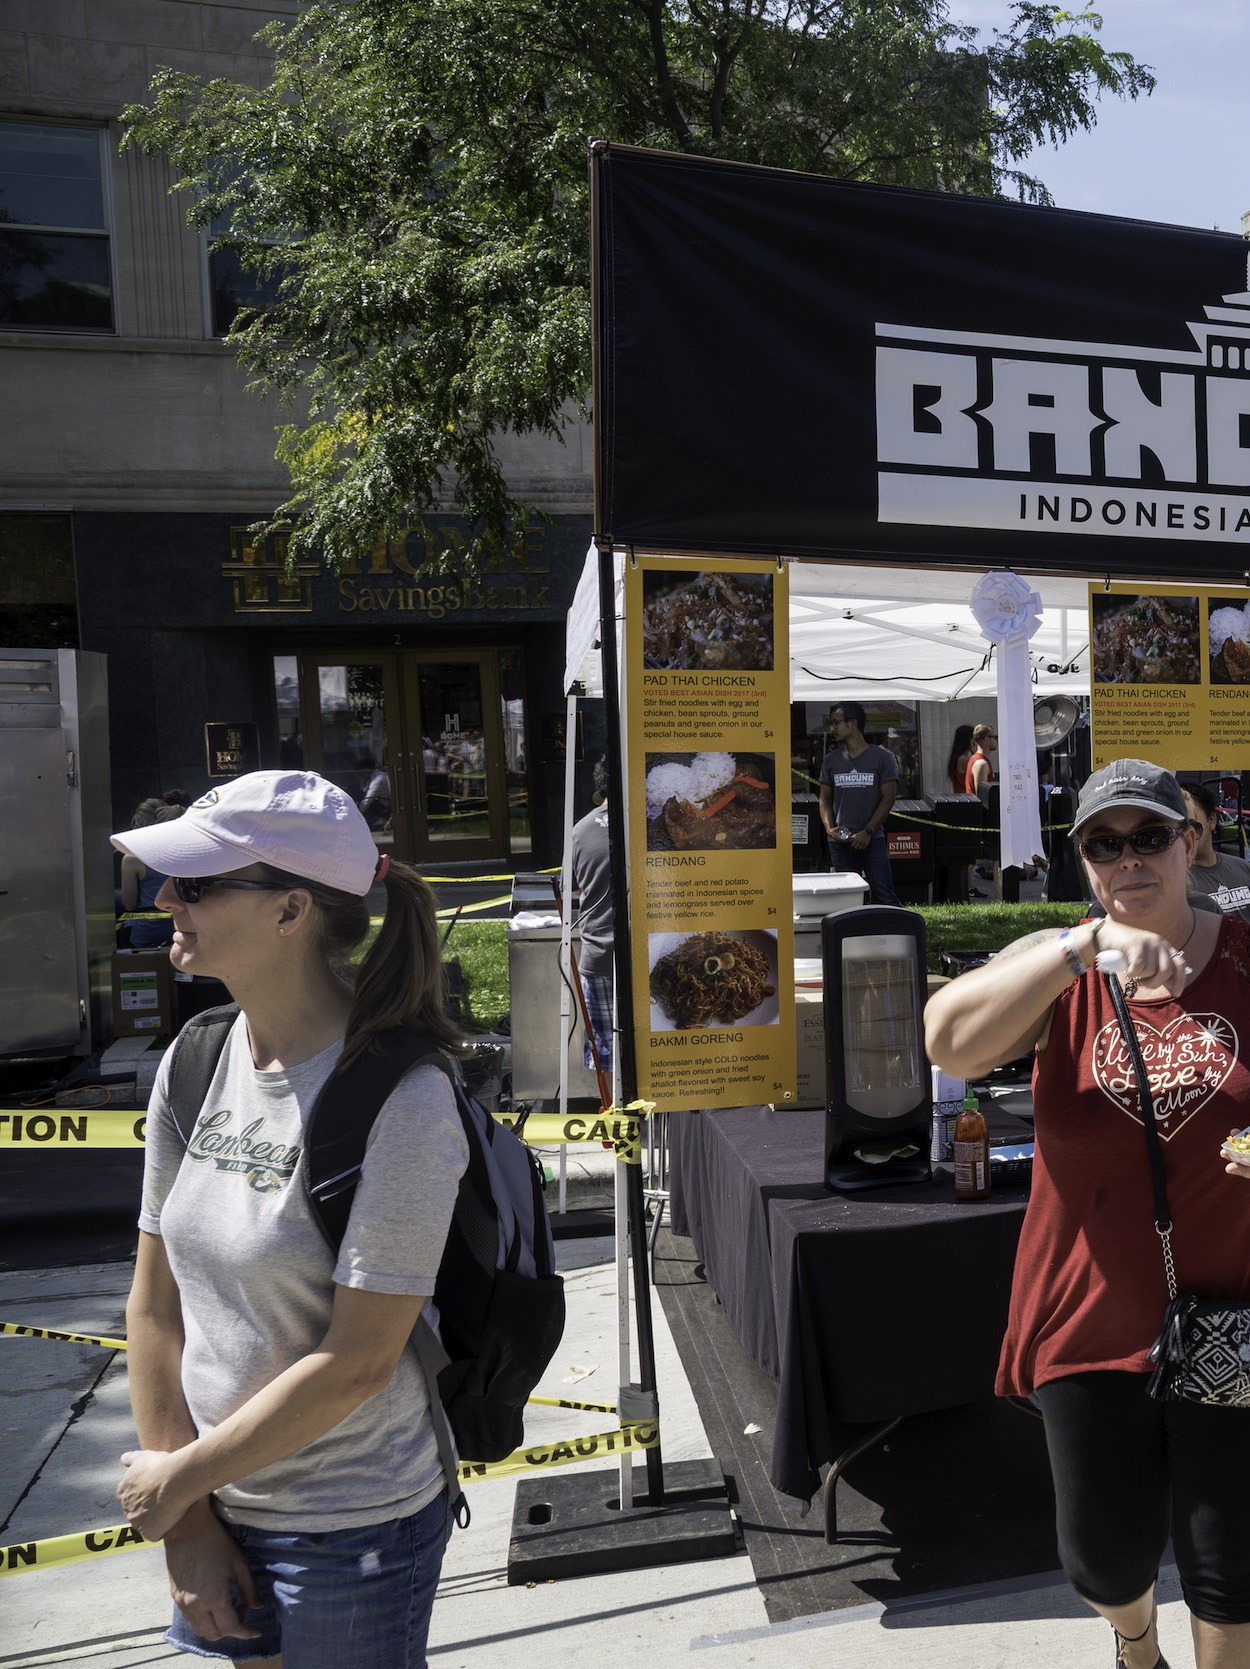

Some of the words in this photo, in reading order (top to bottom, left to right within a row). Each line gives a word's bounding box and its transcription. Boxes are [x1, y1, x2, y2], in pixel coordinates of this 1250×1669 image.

[394, 634, 402, 644] 2
[644, 676, 667, 685] PAD
[671, 676, 698, 686] THAI
[702, 676, 755, 686] CHICKEN
[1094, 689, 1114, 698] PAD
[1117, 689, 1139, 698] THAI
[1142, 690, 1186, 698] CHICKEN
[732, 710, 759, 718] ground
[440, 732, 466, 740] HOME
[644, 731, 672, 739] special
[764, 730, 773, 738] $4
[216, 751, 247, 762] HOM
[1095, 757, 1103, 765] $4
[646, 856, 706, 867] RENDANG
[725, 878, 748, 886] potato
[687, 889, 694, 897] in
[740, 888, 763, 896] spices
[674, 911, 698, 920] yellow
[650, 1036, 687, 1047] BAKMI
[691, 1033, 743, 1045] GORENG
[1176, 1033, 1193, 1043] the
[1097, 1027, 1156, 1068] lie
[1158, 1043, 1175, 1063] by
[1177, 1043, 1227, 1067] Sun,
[650, 1060, 692, 1068] Indonesian
[695, 1058, 712, 1066] style
[740, 1054, 769, 1062] noodles
[669, 1070, 691, 1078] green
[1202, 1066, 1221, 1086] by
[651, 1080, 676, 1088] shallot
[678, 1078, 709, 1086] flavored
[728, 1075, 750, 1083] sweet
[752, 1075, 765, 1083] soy
[1159, 1084, 1207, 1113] Moon
